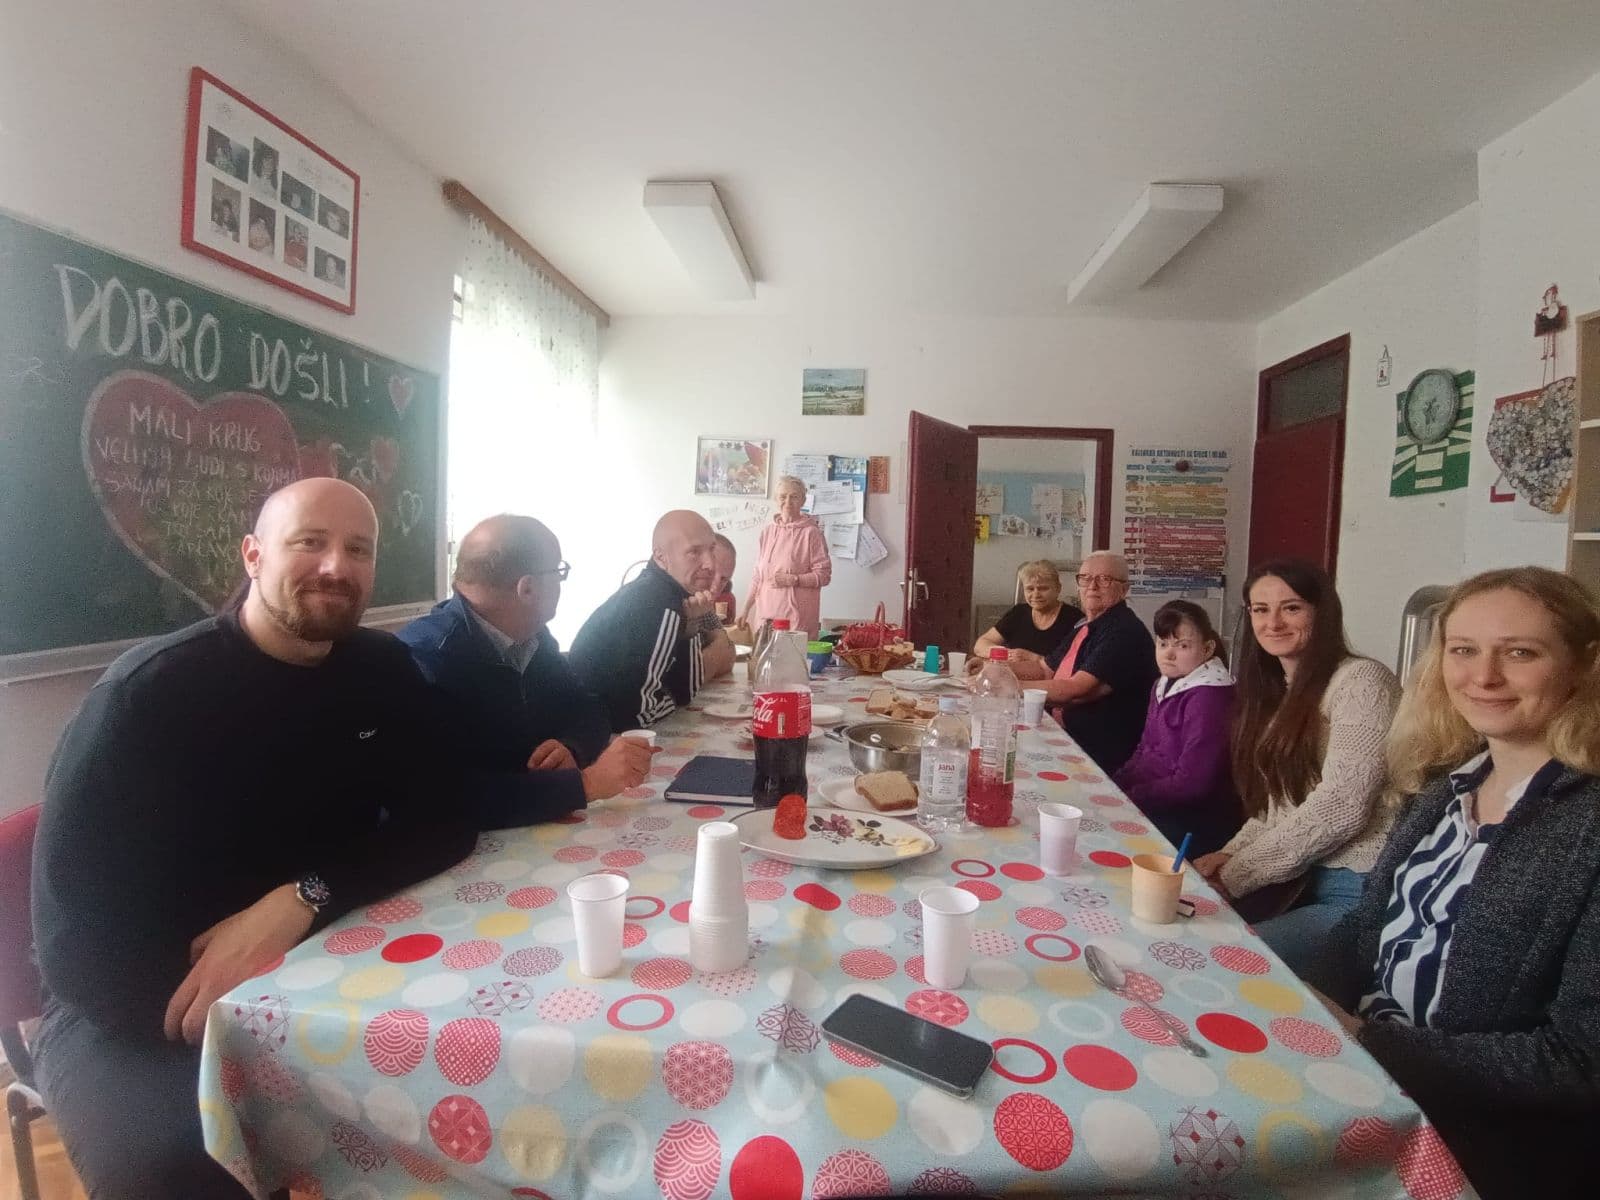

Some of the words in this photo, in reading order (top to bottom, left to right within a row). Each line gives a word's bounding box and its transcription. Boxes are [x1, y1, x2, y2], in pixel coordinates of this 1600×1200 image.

[53, 264, 222, 384] DOBRO
[249, 333, 348, 408] DOŠLI
[129, 402, 192, 444] MALI
[209, 422, 261, 453] KRUG
